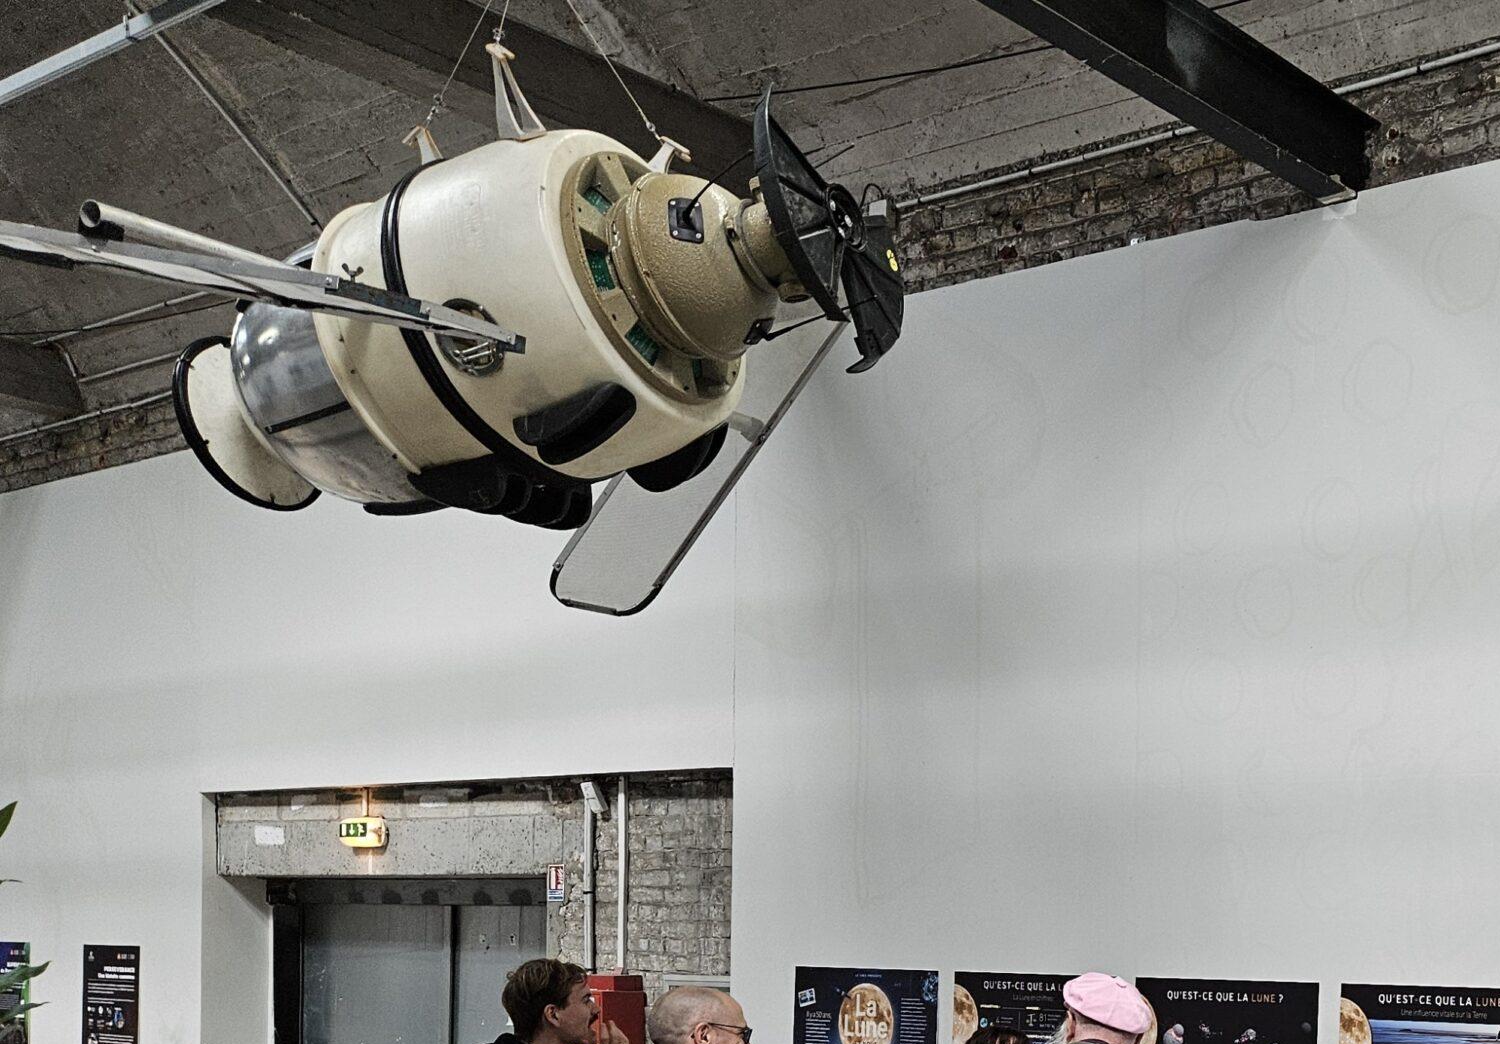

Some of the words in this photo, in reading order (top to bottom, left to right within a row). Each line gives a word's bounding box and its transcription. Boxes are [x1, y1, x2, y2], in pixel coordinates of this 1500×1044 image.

[983, 980, 1025, 990] QU'EST-CE
[1027, 981, 1043, 991] QUE
[1045, 982, 1056, 992] LA
[1166, 990, 1213, 1001] QU'EST-CE
[1215, 992, 1235, 1003] QUE
[1237, 993, 1249, 1002] LA
[1251, 993, 1276, 1004] LUNE
[1278, 993, 1284, 1004] ?
[1378, 993, 1432, 1005] QU'EST-CE
[1435, 995, 1456, 1007] QUE
[1459, 996, 1473, 1007] LA
[856, 994, 877, 1018] La
[844, 1014, 888, 1039] Lune
